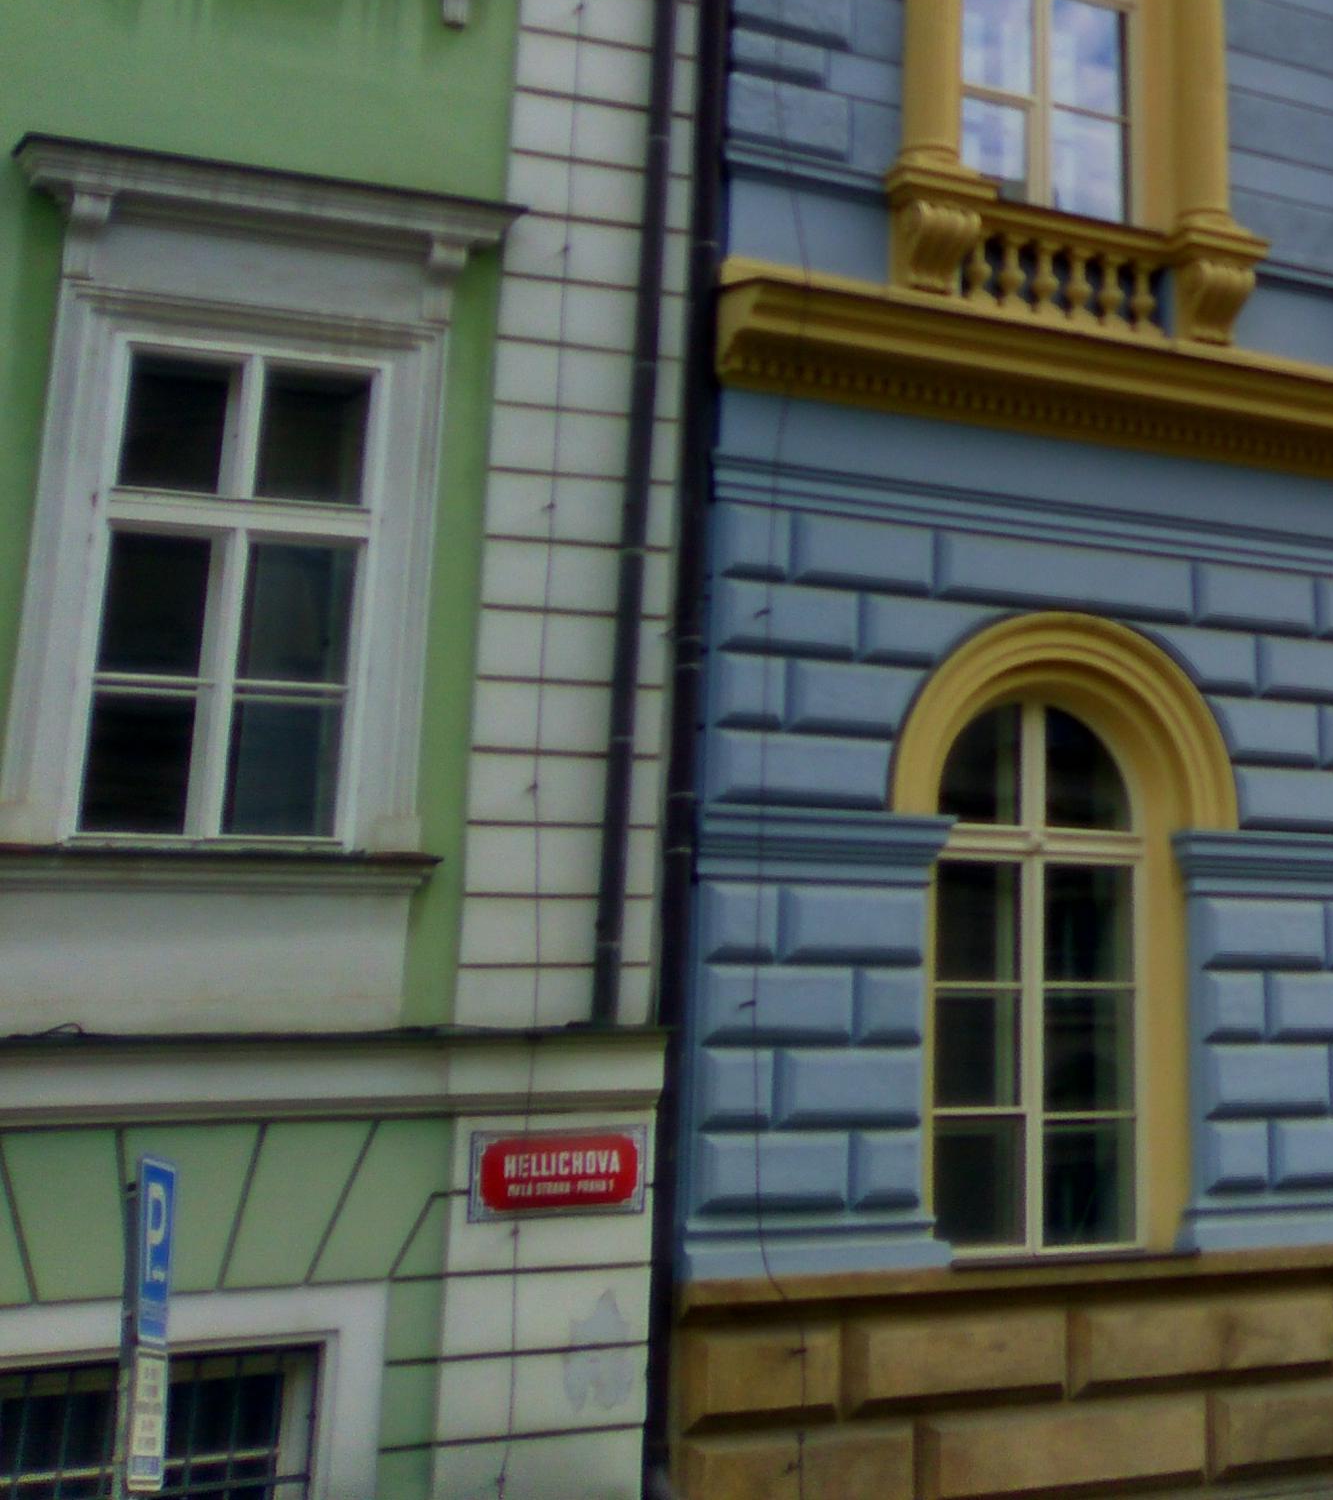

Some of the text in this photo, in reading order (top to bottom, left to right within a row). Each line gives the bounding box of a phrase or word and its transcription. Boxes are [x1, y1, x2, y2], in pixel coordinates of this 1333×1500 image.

[504, 1150, 620, 1177] HELLICHOVA
[536, 1182, 570, 1195] STRANA
[577, 1179, 605, 1193] PRAHA
[146, 1182, 166, 1282] P
